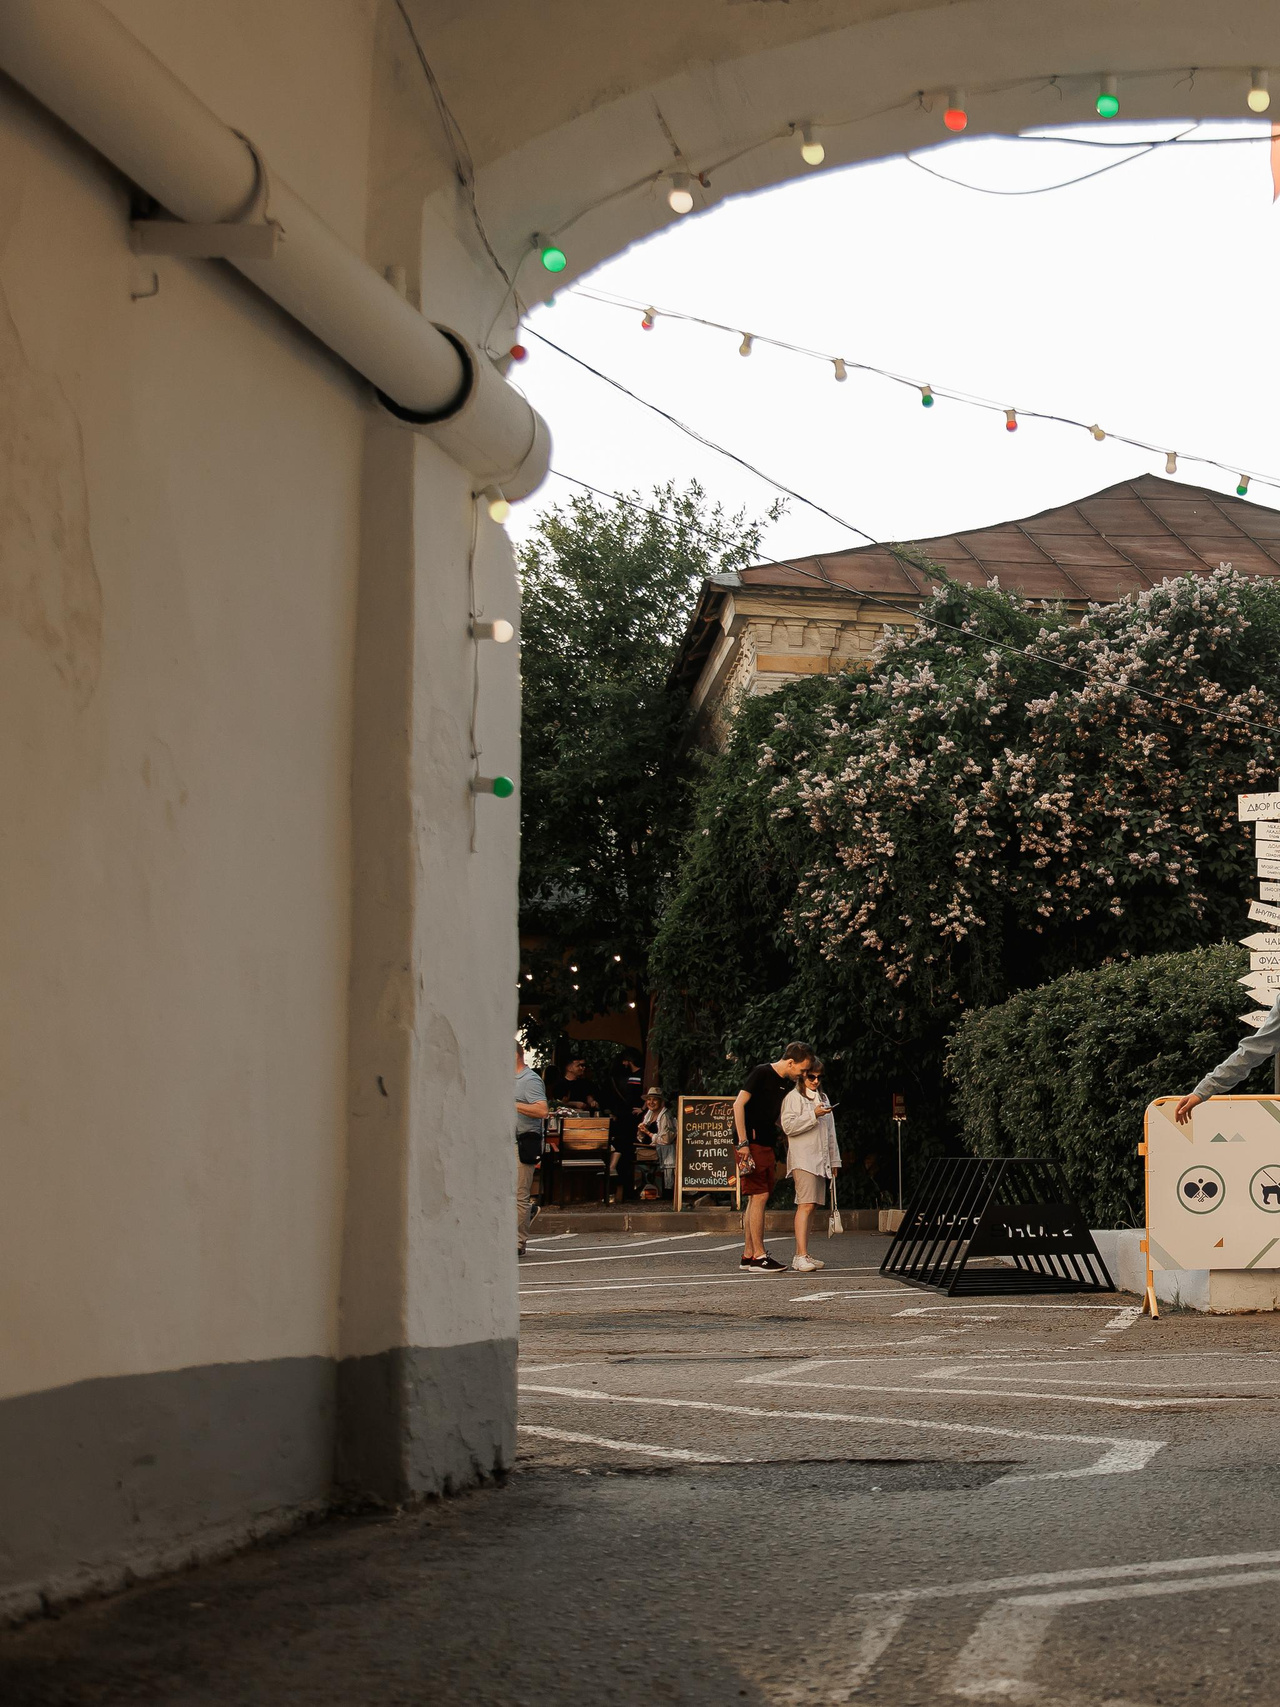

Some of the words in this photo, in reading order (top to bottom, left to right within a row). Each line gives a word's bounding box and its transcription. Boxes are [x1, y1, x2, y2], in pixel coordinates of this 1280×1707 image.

[1247, 802, 1271, 812] ДВОР
[694, 1102, 708, 1116] El
[708, 1101, 735, 1116] Tinto
[686, 1122, 723, 1131] САНГРИЯ
[696, 1148, 728, 1157] ТАПАС
[689, 1162, 714, 1171] КОФЕ
